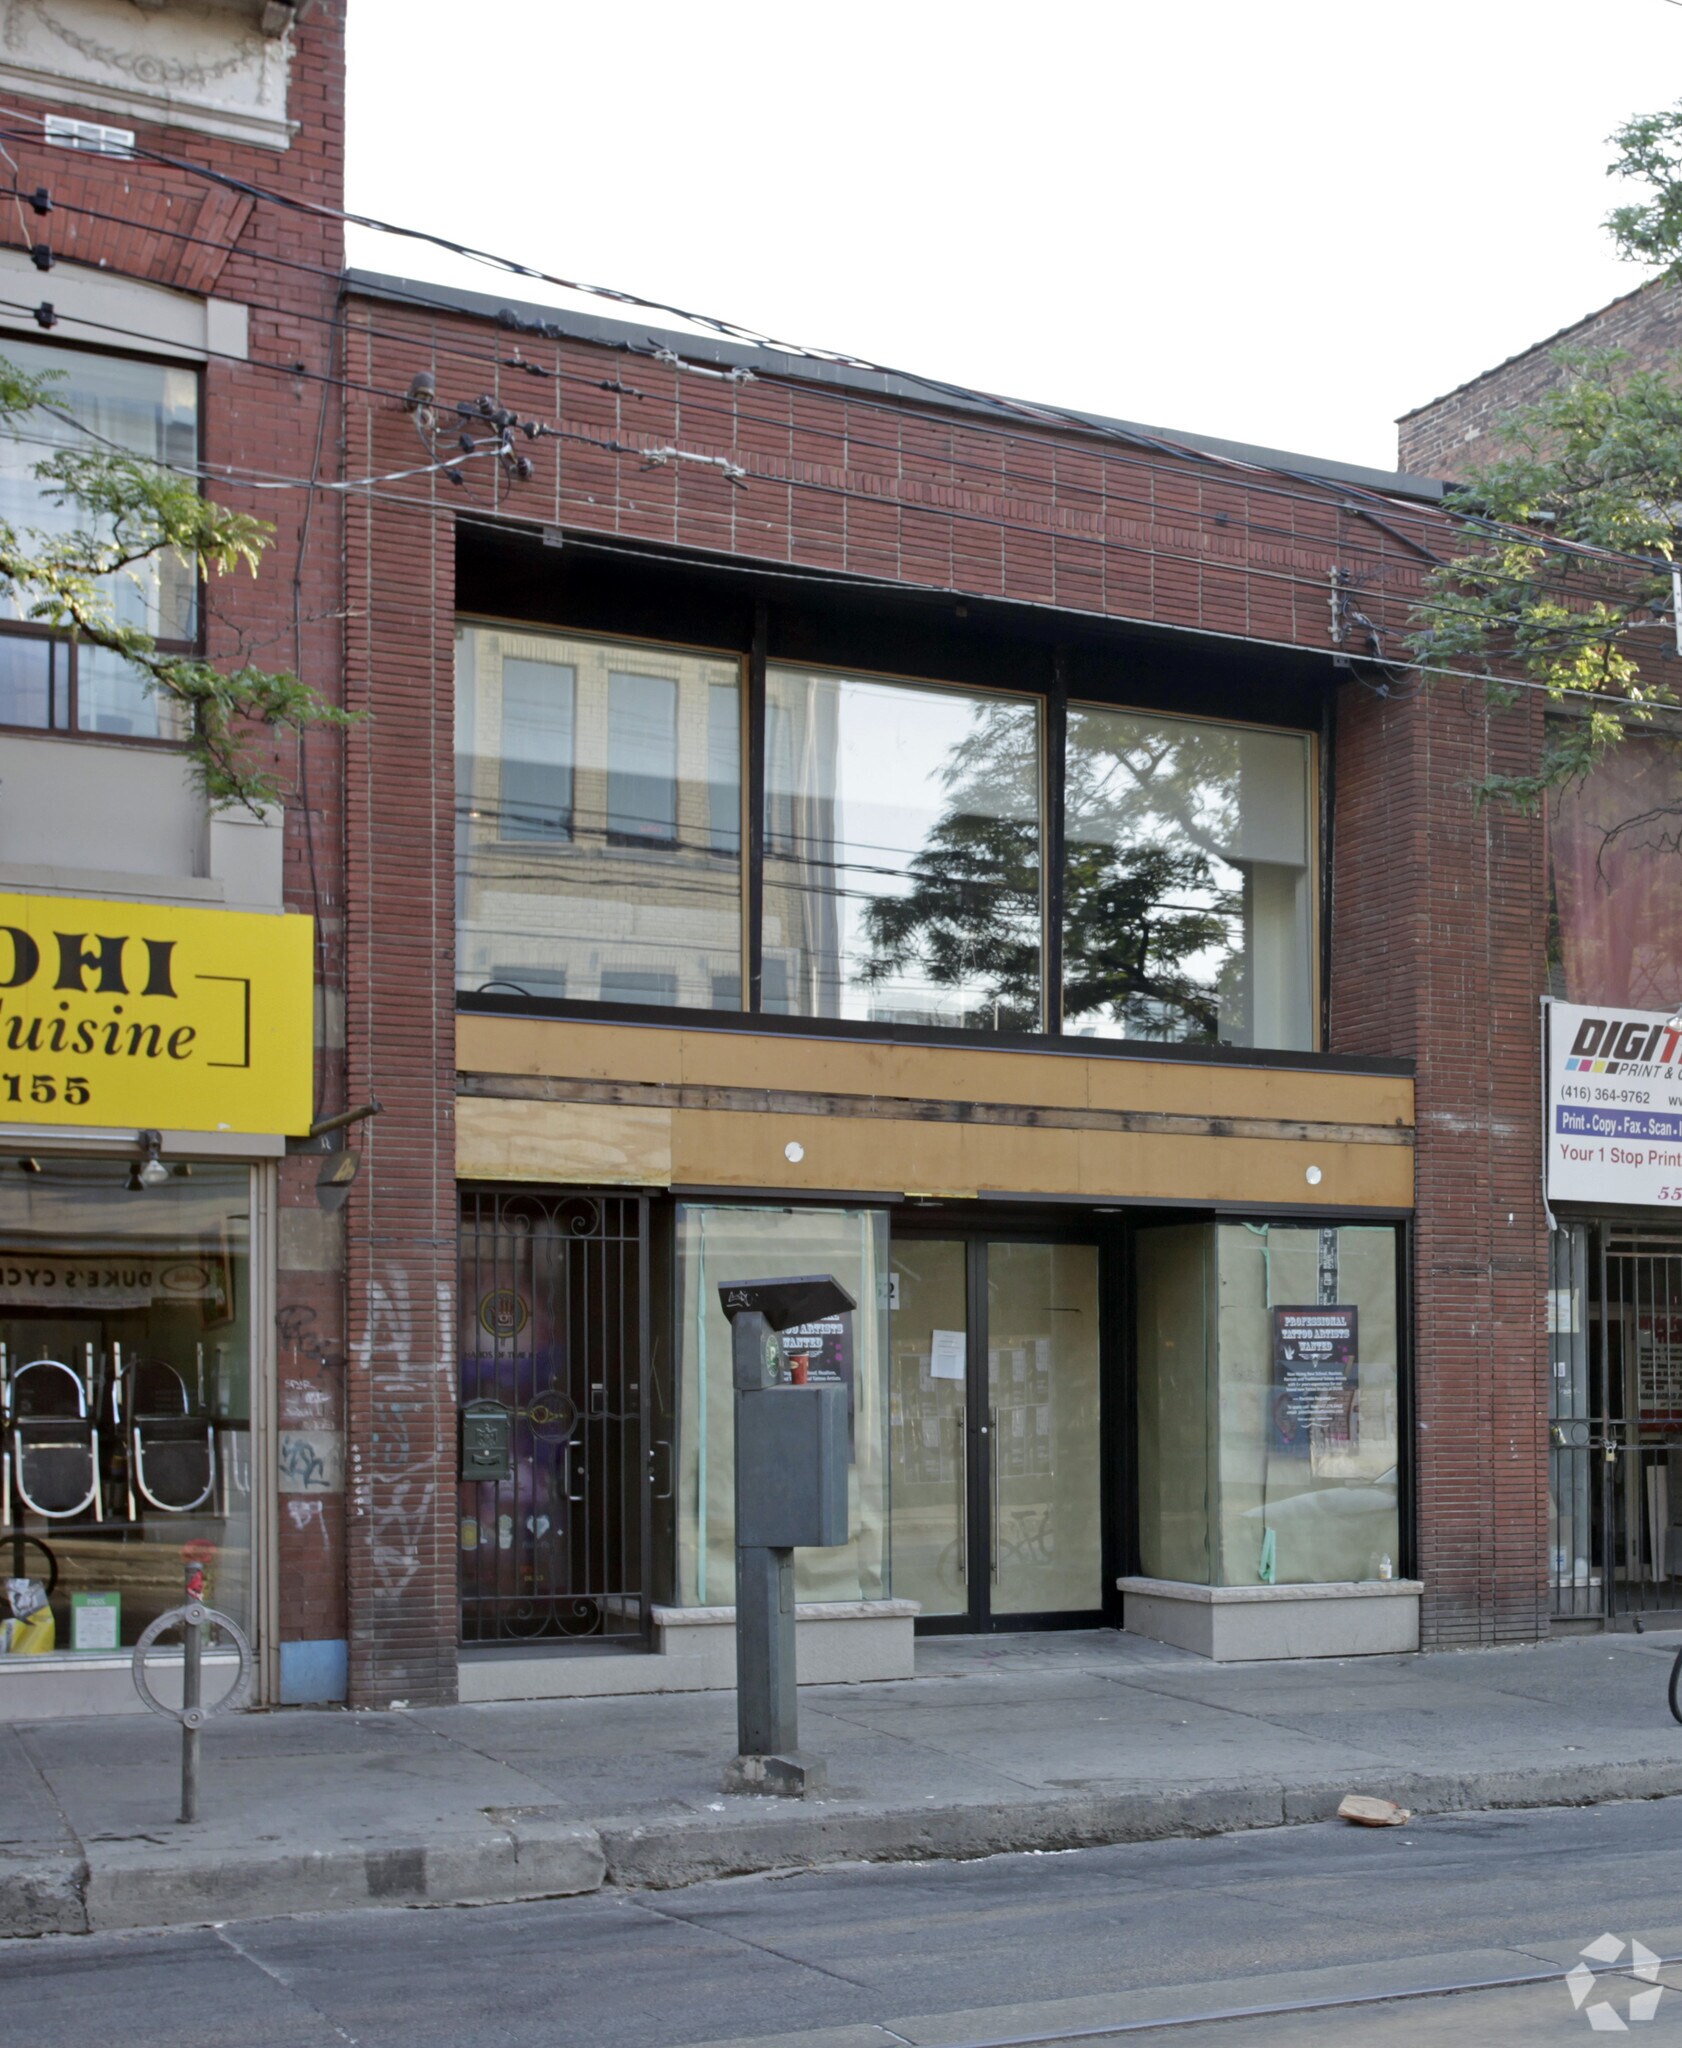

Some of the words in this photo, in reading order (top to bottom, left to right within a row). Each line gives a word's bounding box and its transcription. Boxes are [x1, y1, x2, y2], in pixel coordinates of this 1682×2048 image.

[0, 999, 196, 1060] uisine
[1570, 1018, 1682, 1065] DIGIT
[1618, 1062, 1662, 1079] PRINT
[1664, 1066, 1673, 1079] &
[1561, 1084, 1591, 1102] (416)
[1594, 1087, 1650, 1104] 364-9762
[1562, 1111, 1585, 1130] Print
[1592, 1114, 1617, 1136] Copy
[1624, 1116, 1641, 1134] Fax
[1648, 1118, 1672, 1136] Scan
[1560, 1144, 1594, 1161] Your
[1598, 1147, 1605, 1162] 1
[1610, 1147, 1644, 1168] Stop
[800, 1323, 843, 1335] ARTISTS
[1284, 1316, 1347, 1327] PROFESSIONAL
[1281, 1328, 1313, 1339] TATTOO
[1313, 1328, 1350, 1339] ARTISTS
[1298, 1341, 1333, 1352] WANTED
